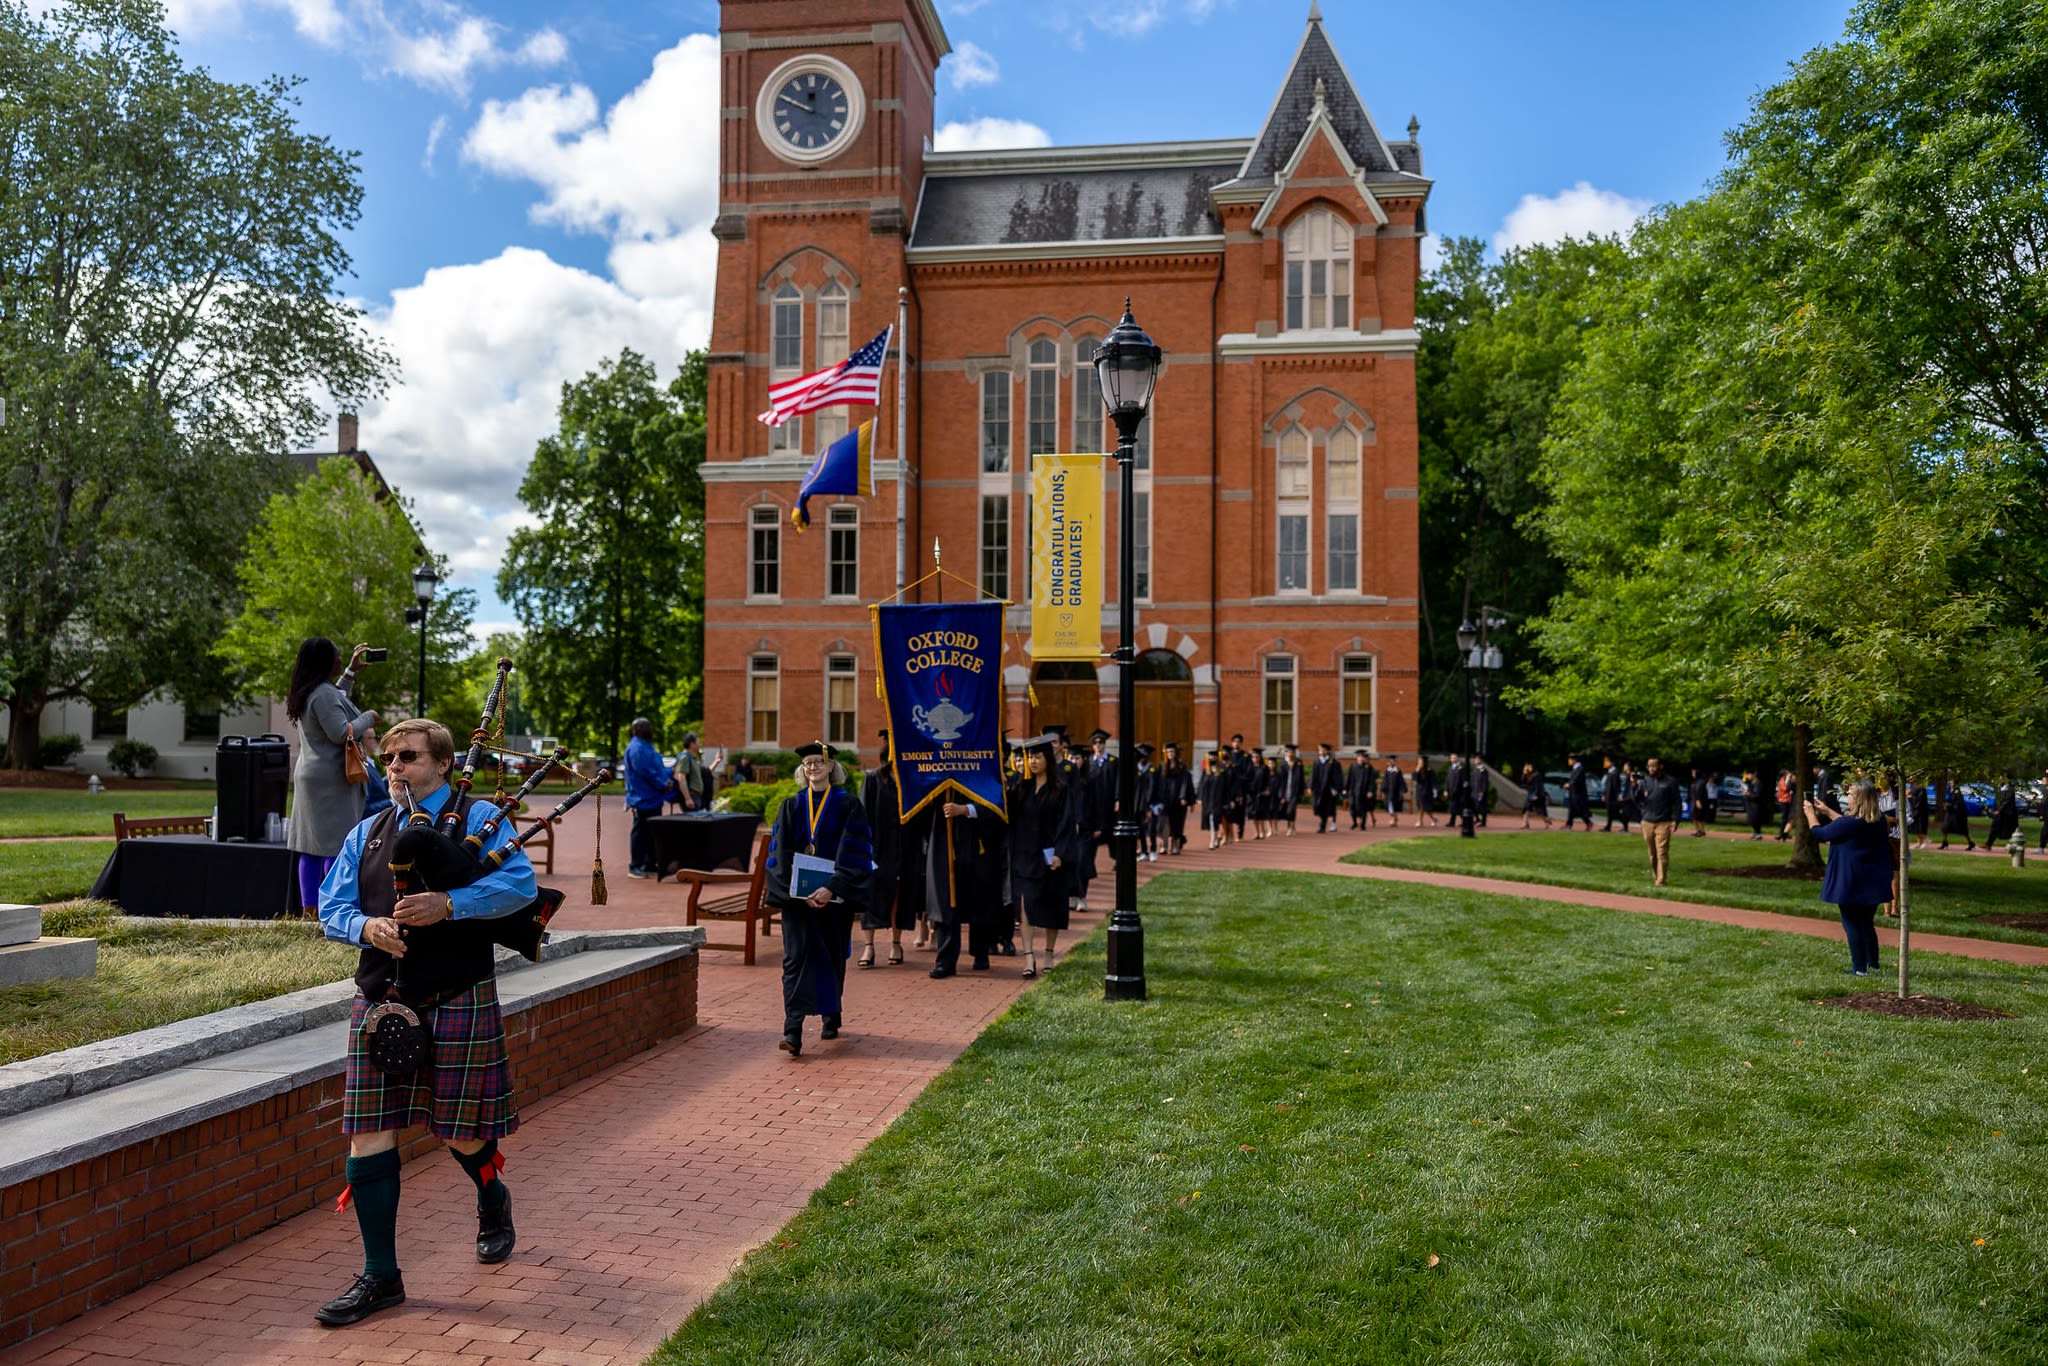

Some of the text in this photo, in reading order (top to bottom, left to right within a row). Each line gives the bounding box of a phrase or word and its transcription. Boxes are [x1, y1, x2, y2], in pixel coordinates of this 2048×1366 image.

[1051, 470, 1069, 607] CONGRATULATIONS,
[1069, 520, 1082, 607] GRADUATES!
[908, 631, 979, 652] OXFORD
[905, 649, 984, 674] COLLEGE
[901, 750, 995, 761] EMORY UNIVERSITY
